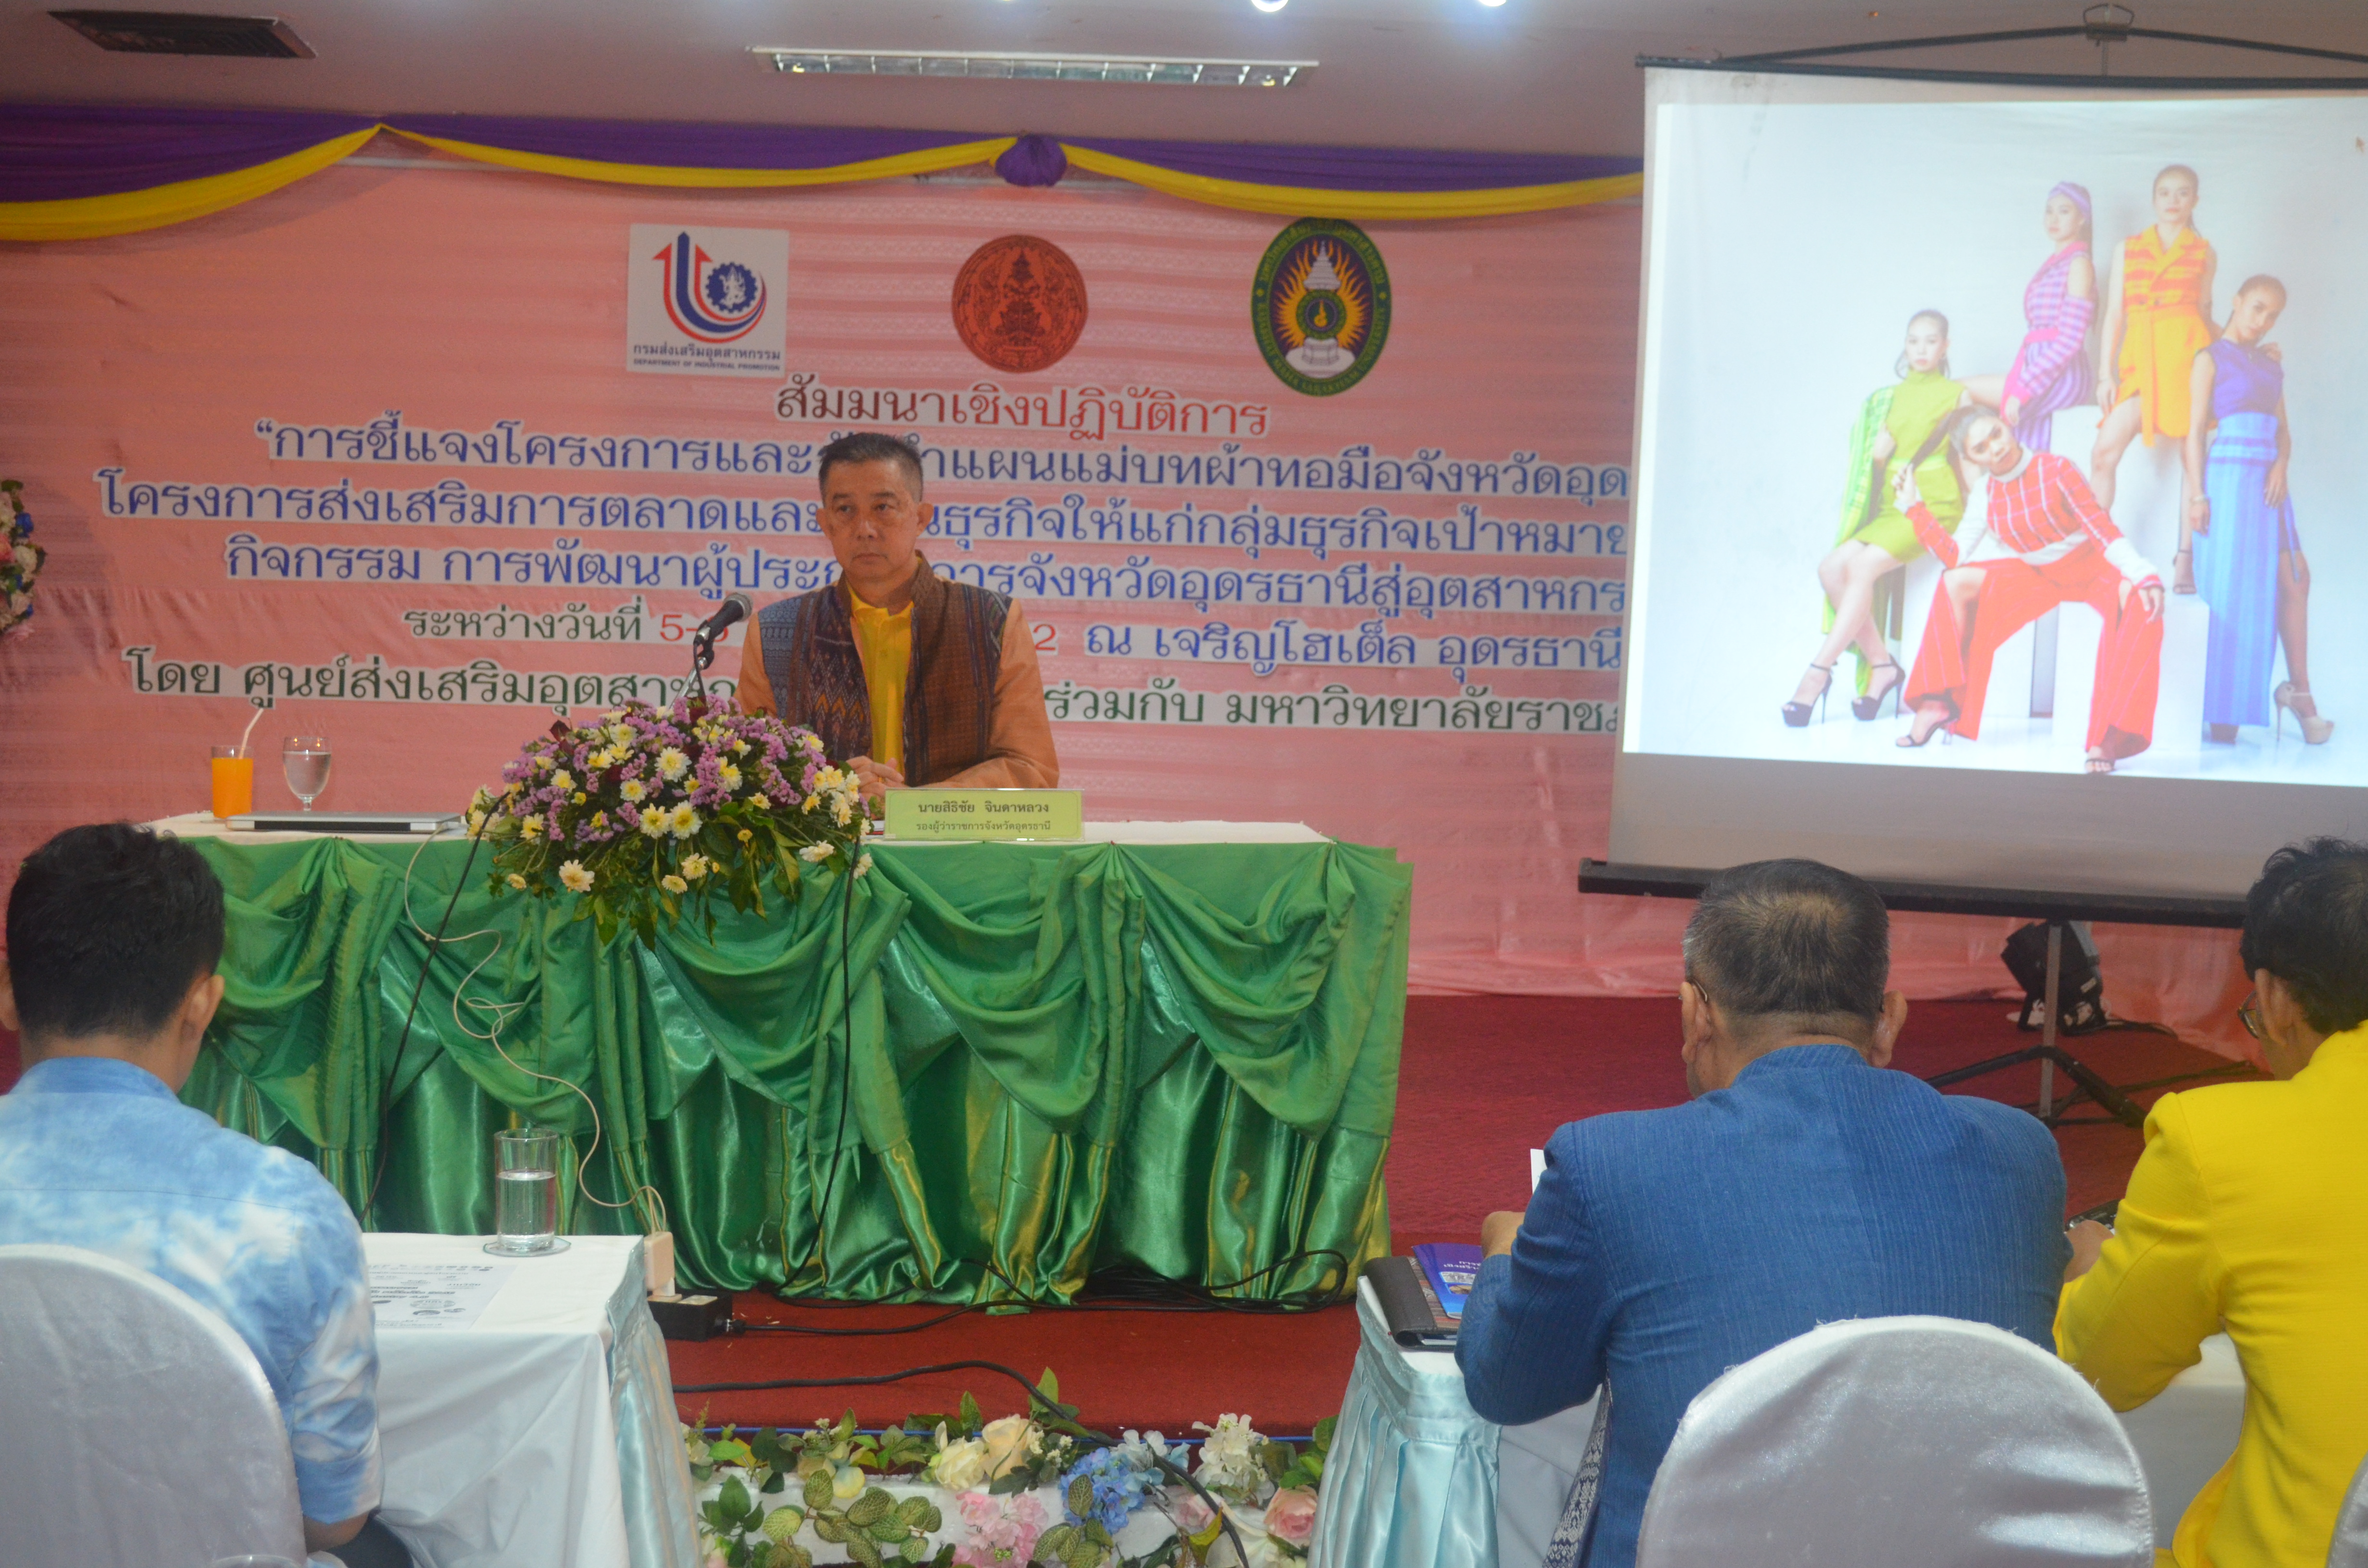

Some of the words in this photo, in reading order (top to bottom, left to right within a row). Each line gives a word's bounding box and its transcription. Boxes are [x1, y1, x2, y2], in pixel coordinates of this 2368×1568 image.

[634, 341, 780, 364] กรมส่งเสริมอุตสาหกรรม
[777, 373, 1268, 441] สัมมนาเชิงปฏิบัติการ
[228, 533, 421, 580] กิจกรรม
[405, 595, 641, 640] ระหว่างวันที่
[1087, 624, 1131, 655] ณ
[1156, 619, 1415, 673] เจริญโฮเต็ล
[1439, 627, 1621, 684] อุดรธานี
[126, 647, 220, 694] โดย
[916, 820, 1050, 833] รองผู้ว่าราชการจังหวัดอุดรธานี
[985, 800, 1049, 812] จินดาหลวง
